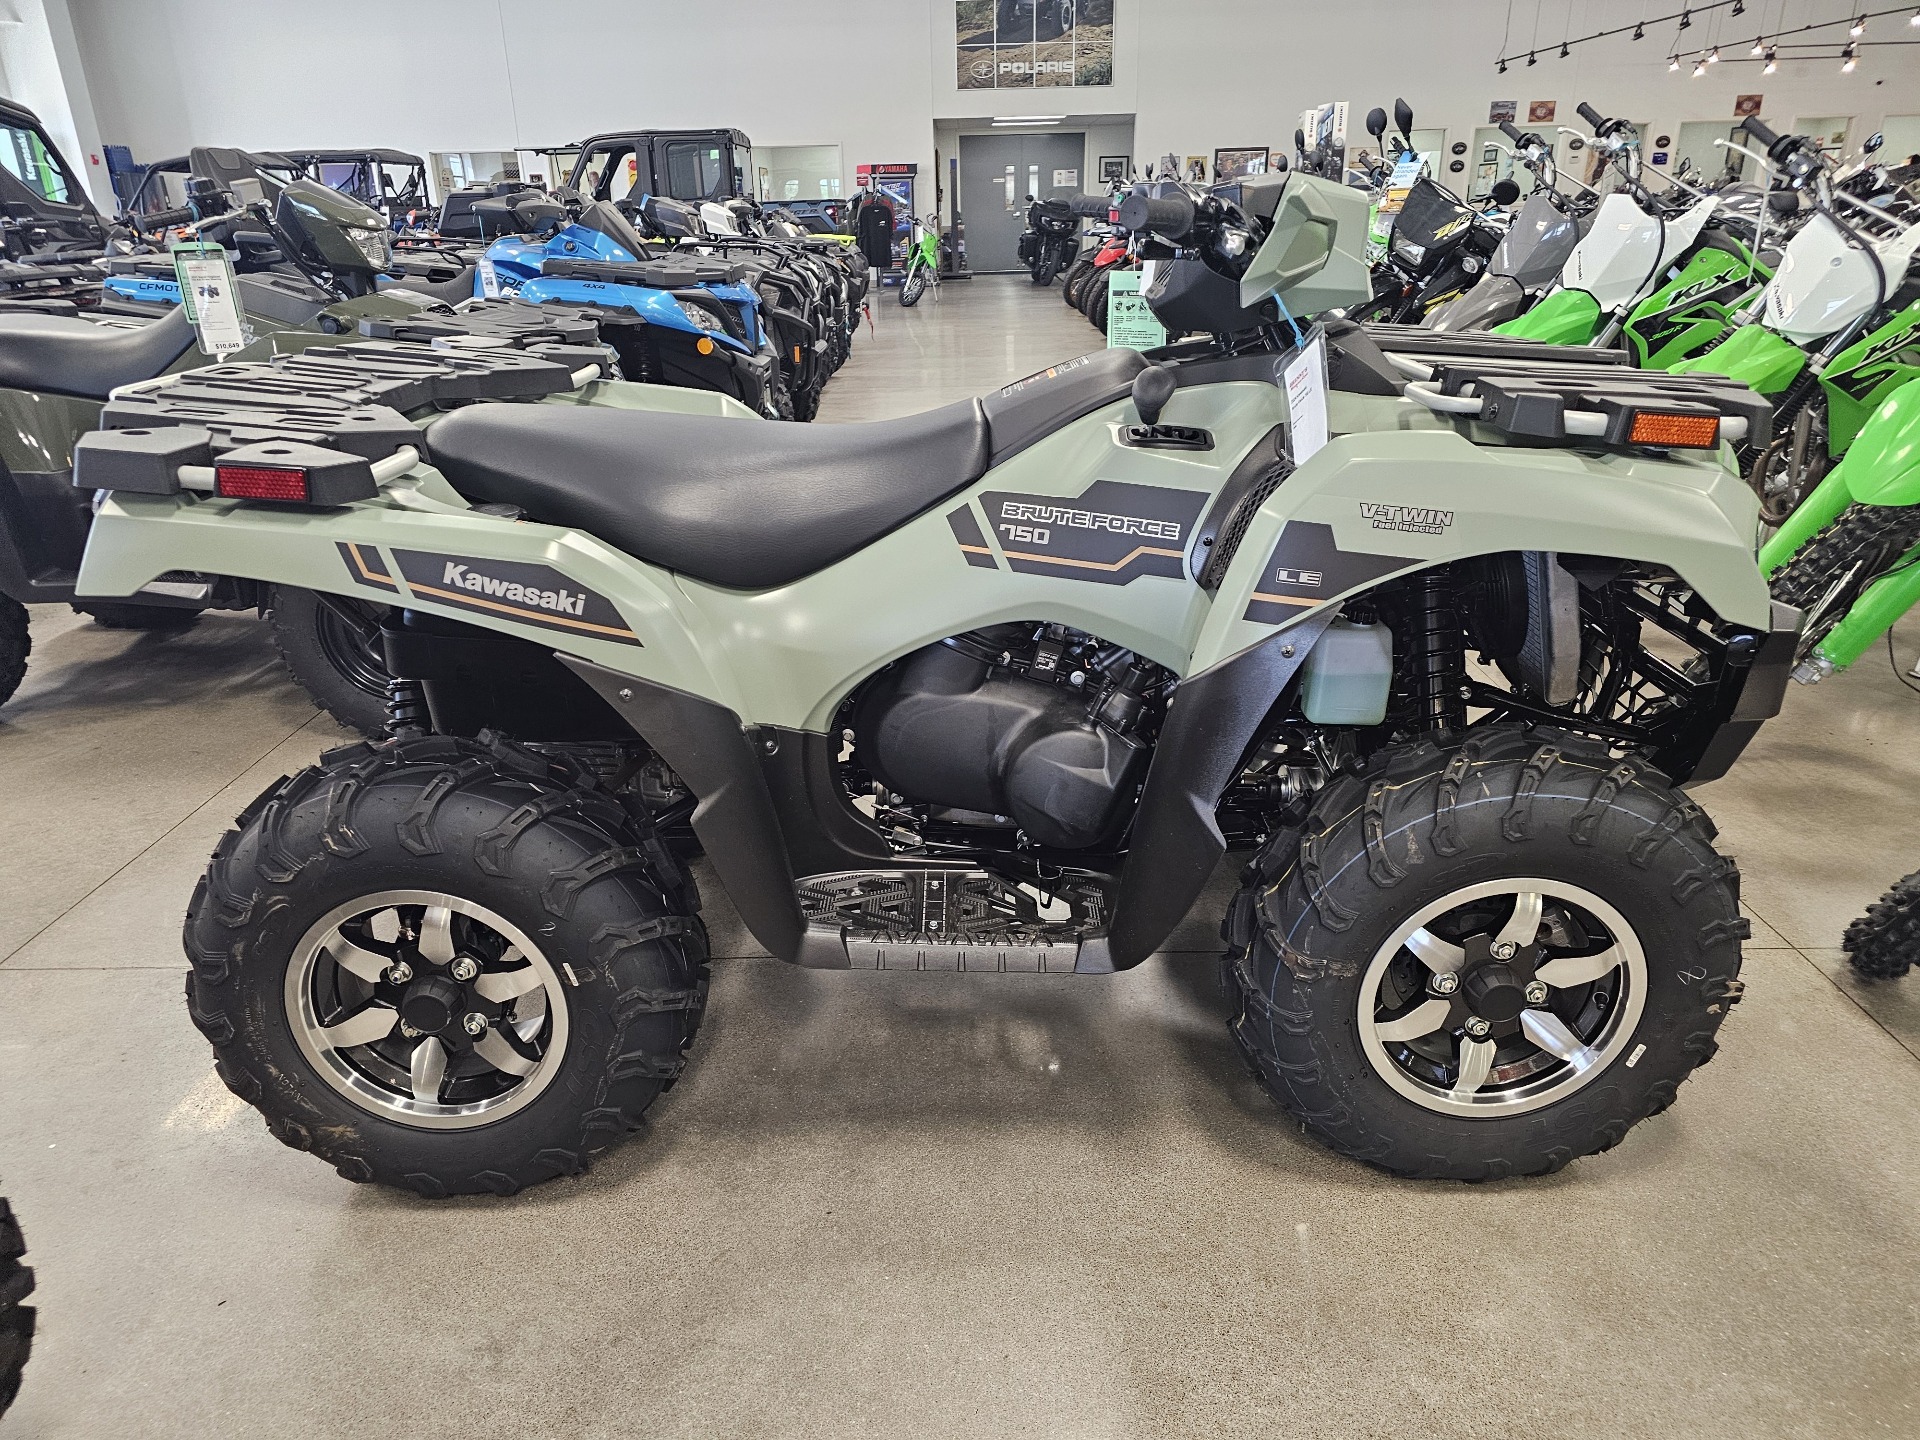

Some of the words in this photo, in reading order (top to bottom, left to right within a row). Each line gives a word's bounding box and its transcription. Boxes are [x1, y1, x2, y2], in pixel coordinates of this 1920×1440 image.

[999, 61, 1073, 75] POLARIS
[1664, 264, 1740, 311] KLX
[1774, 284, 1785, 320] Kawasaki
[1360, 502, 1454, 527] V-TWIN
[1000, 523, 1050, 545] 750
[1372, 520, 1397, 531] Fuel
[1397, 522, 1444, 536] Injected
[442, 561, 587, 616] Kawasaki
[1277, 569, 1321, 585] LE
